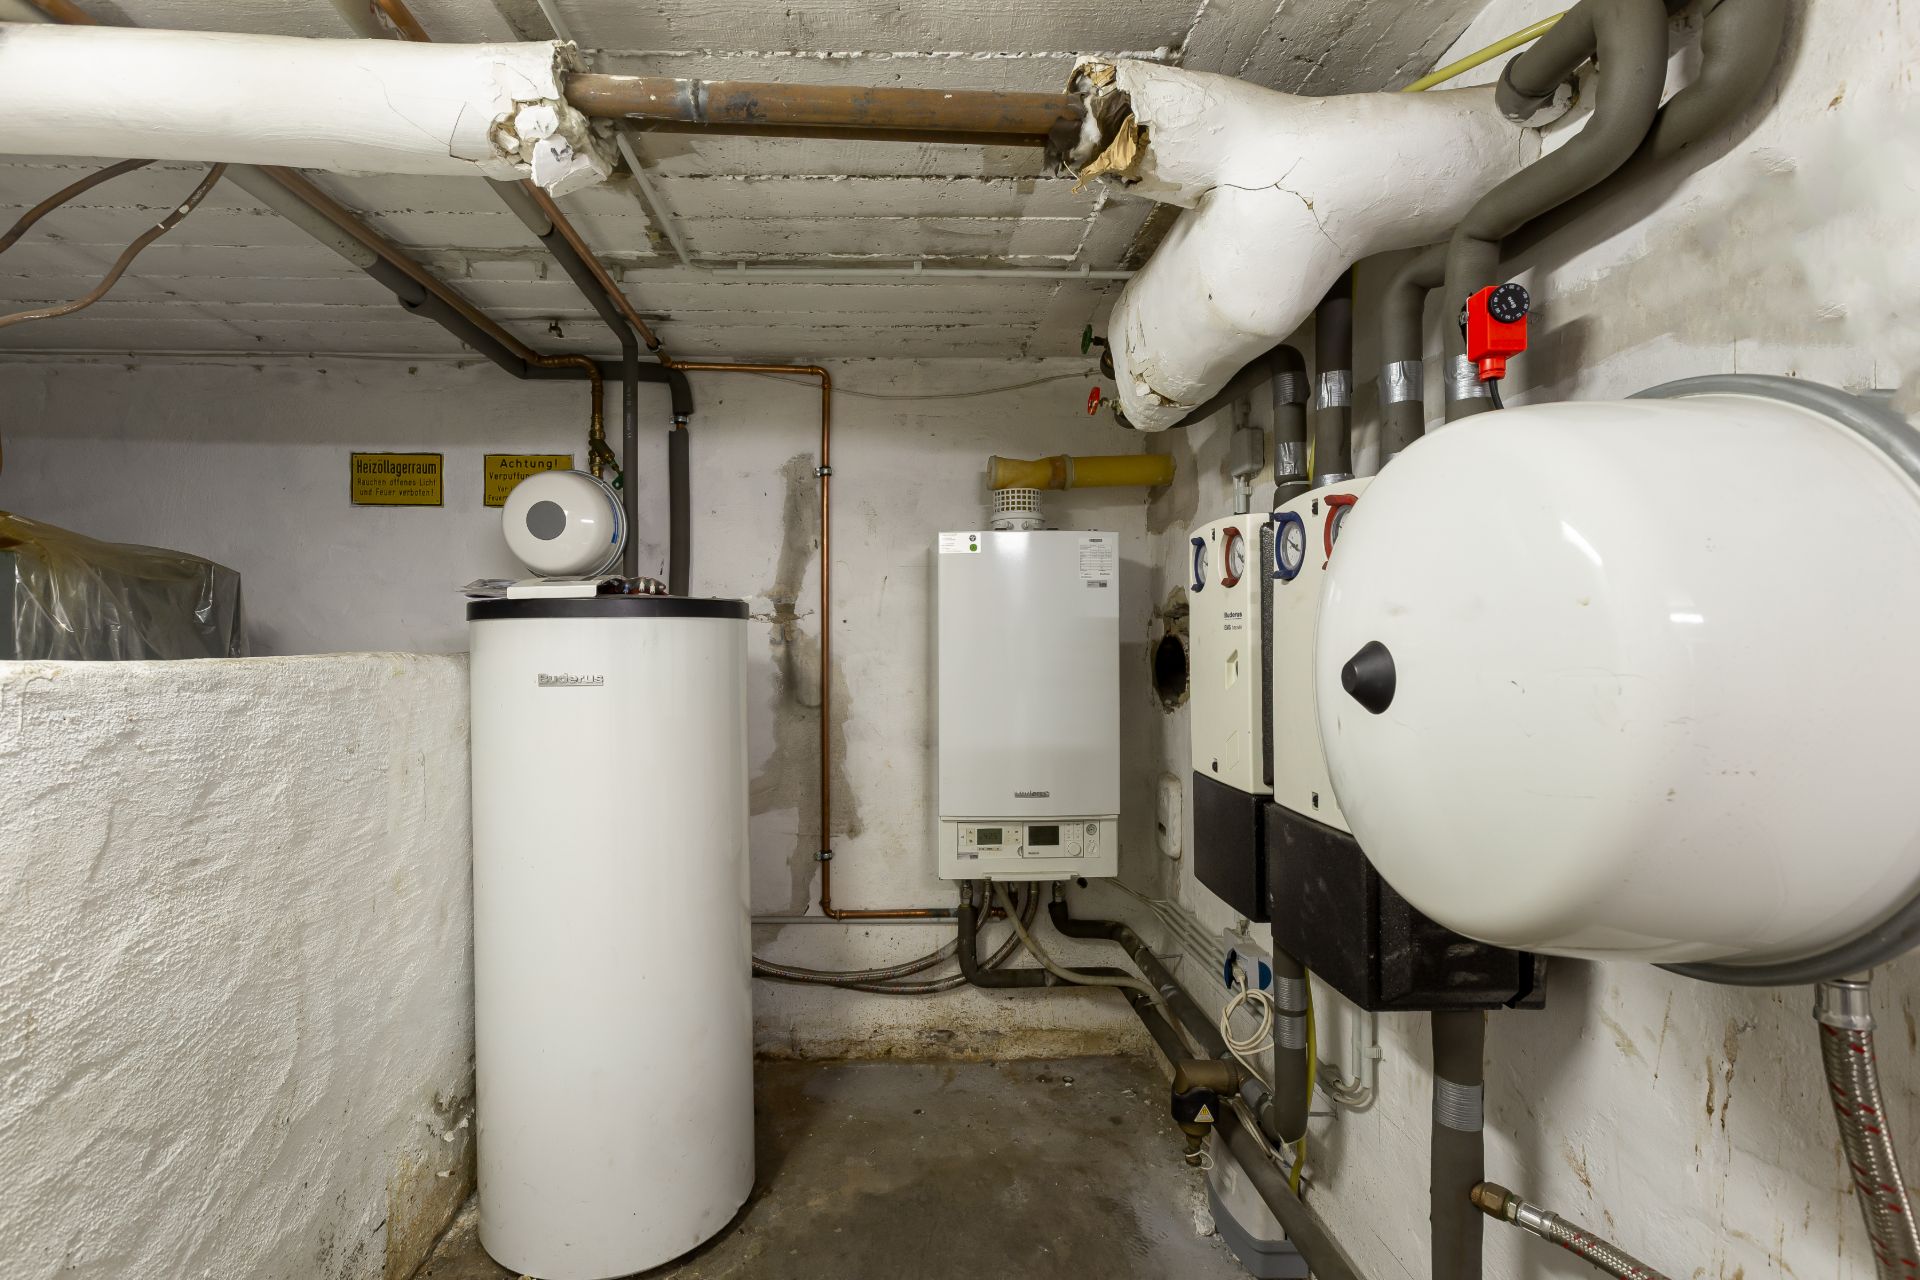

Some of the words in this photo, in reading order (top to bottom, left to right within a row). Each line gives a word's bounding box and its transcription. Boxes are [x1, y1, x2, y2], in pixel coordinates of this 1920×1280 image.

[356, 459, 437, 477] Heizöllagerraum
[499, 458, 558, 470] Achtung!
[357, 478, 387, 486] Rauchen
[419, 478, 436, 486] Licht
[359, 488, 373, 496] und
[375, 488, 395, 496] Feuer
[538, 673, 604, 685] Buderus
